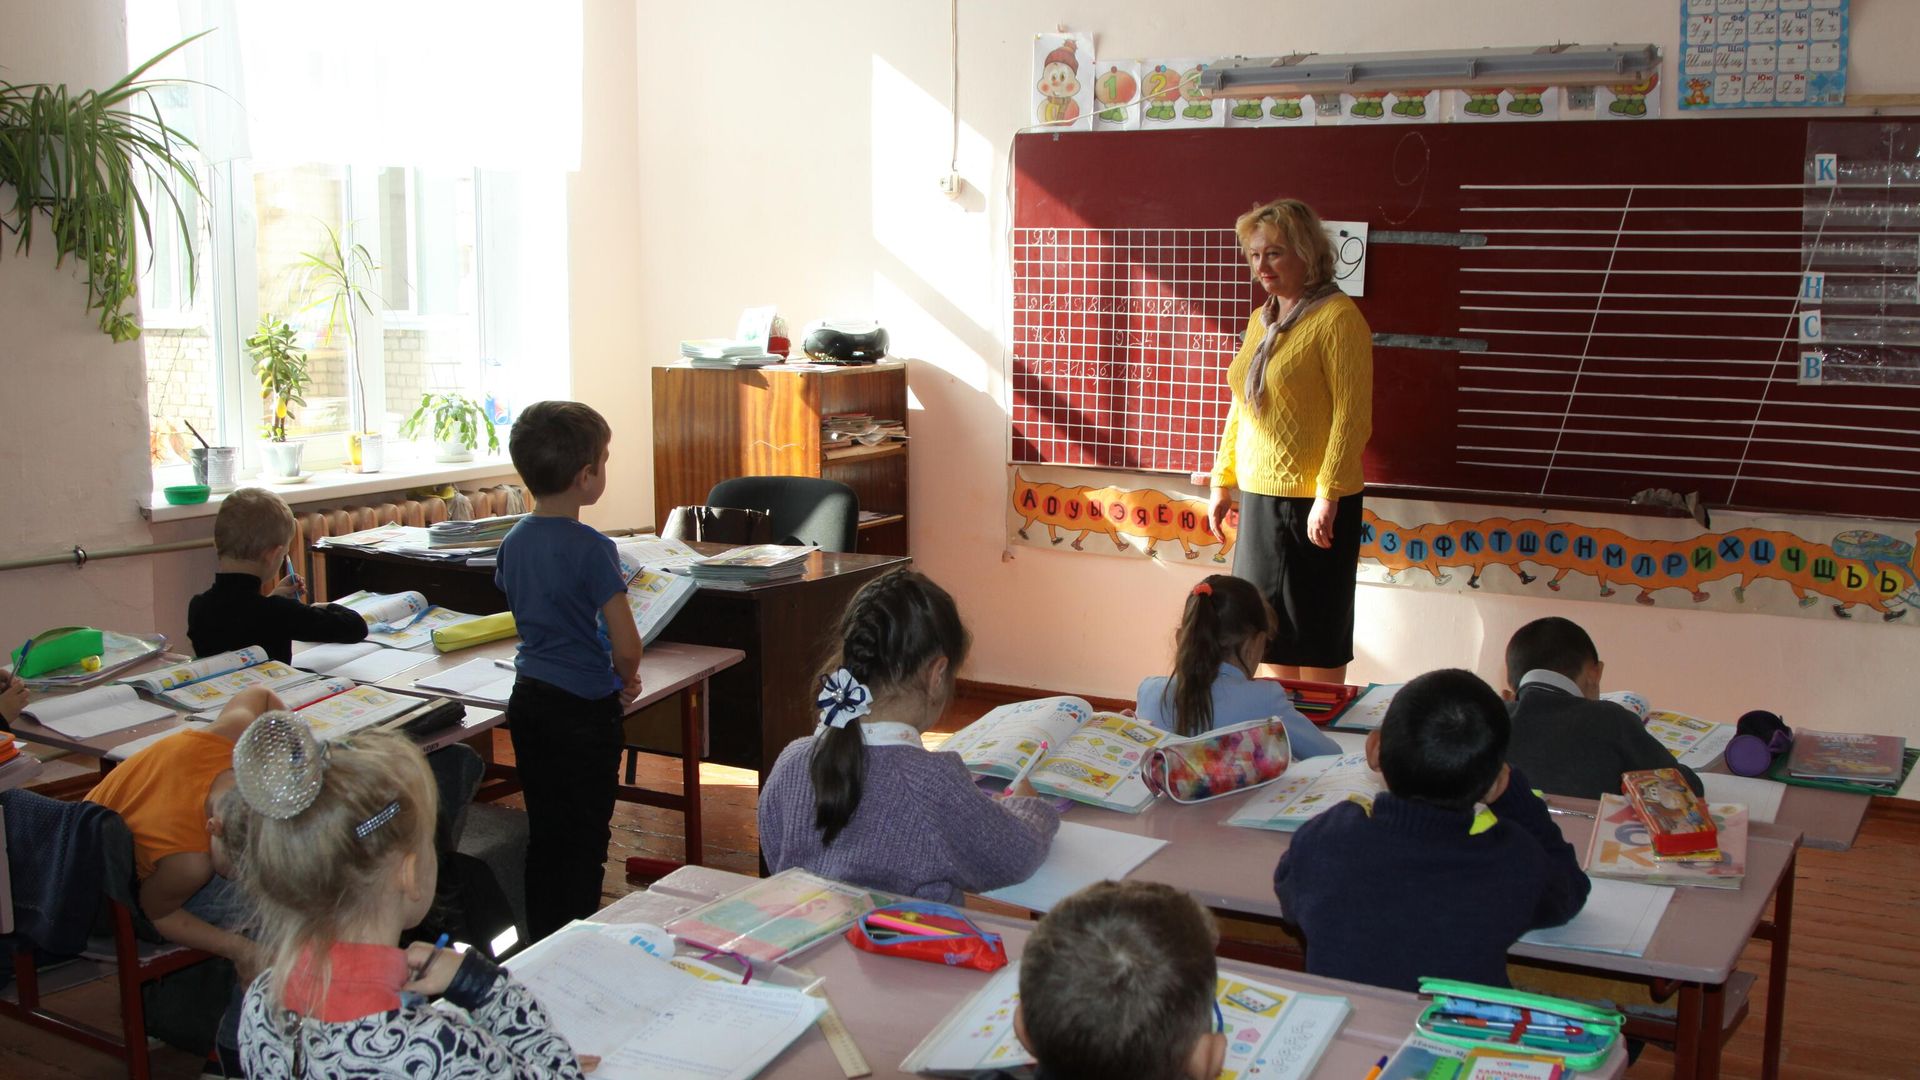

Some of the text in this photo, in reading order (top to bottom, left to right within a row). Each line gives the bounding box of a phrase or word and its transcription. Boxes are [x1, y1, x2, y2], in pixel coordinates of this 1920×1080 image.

[1104, 75, 1118, 99] 1
[1151, 74, 1168, 97] 2
[1817, 158, 1835, 181] К
[1803, 276, 1822, 299] Н
[1804, 315, 1819, 338] С
[1803, 356, 1821, 379] В
[1023, 488, 1037, 508] А
[1048, 495, 1057, 516] О
[1069, 501, 1079, 519] У
[1091, 501, 1102, 517] Ы
[1114, 503, 1125, 520] Э
[1136, 508, 1147, 526] Я
[1181, 511, 1195, 529] Ю
[1383, 532, 1397, 552] З
[1410, 540, 1423, 560] П
[1435, 535, 1452, 557] Ф
[1465, 531, 1480, 552] К
[1493, 531, 1507, 552] Т
[1520, 533, 1536, 553] Ш
[1550, 533, 1563, 554] С
[1578, 536, 1593, 559] Н
[1605, 545, 1623, 567] М
[1635, 556, 1650, 576] Л
[1667, 554, 1682, 575] Р
[1720, 537, 1739, 559] Х
[1754, 540, 1770, 564] Ц
[1787, 548, 1801, 572] Ч
[1814, 558, 1836, 581] Щ
[1846, 565, 1863, 589] Ъ
[1880, 570, 1898, 593] Ь
